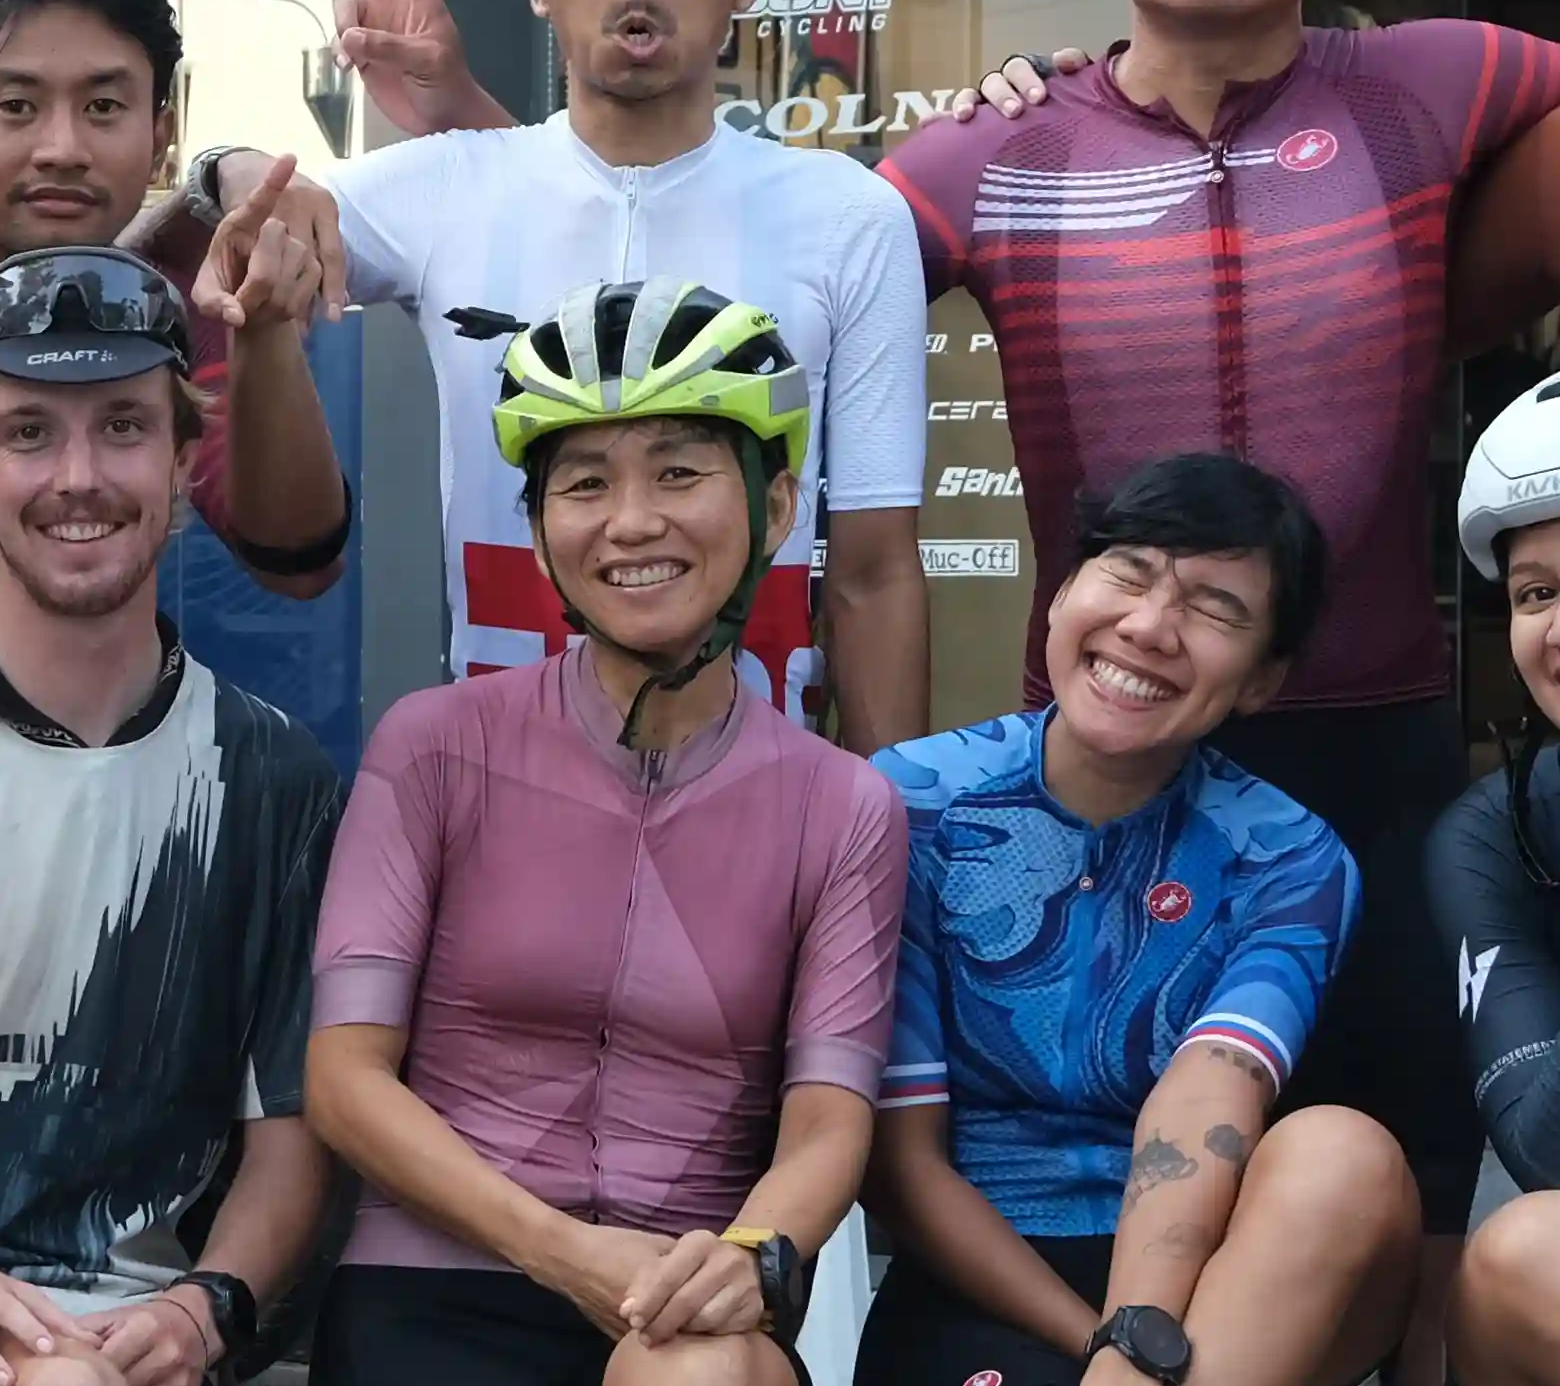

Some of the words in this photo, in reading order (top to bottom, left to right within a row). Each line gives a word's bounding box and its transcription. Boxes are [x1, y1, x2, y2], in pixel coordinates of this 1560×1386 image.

[757, 13, 888, 38] CYCLING
[713, 88, 954, 138] COLN
[26, 349, 99, 365] CRAFT
